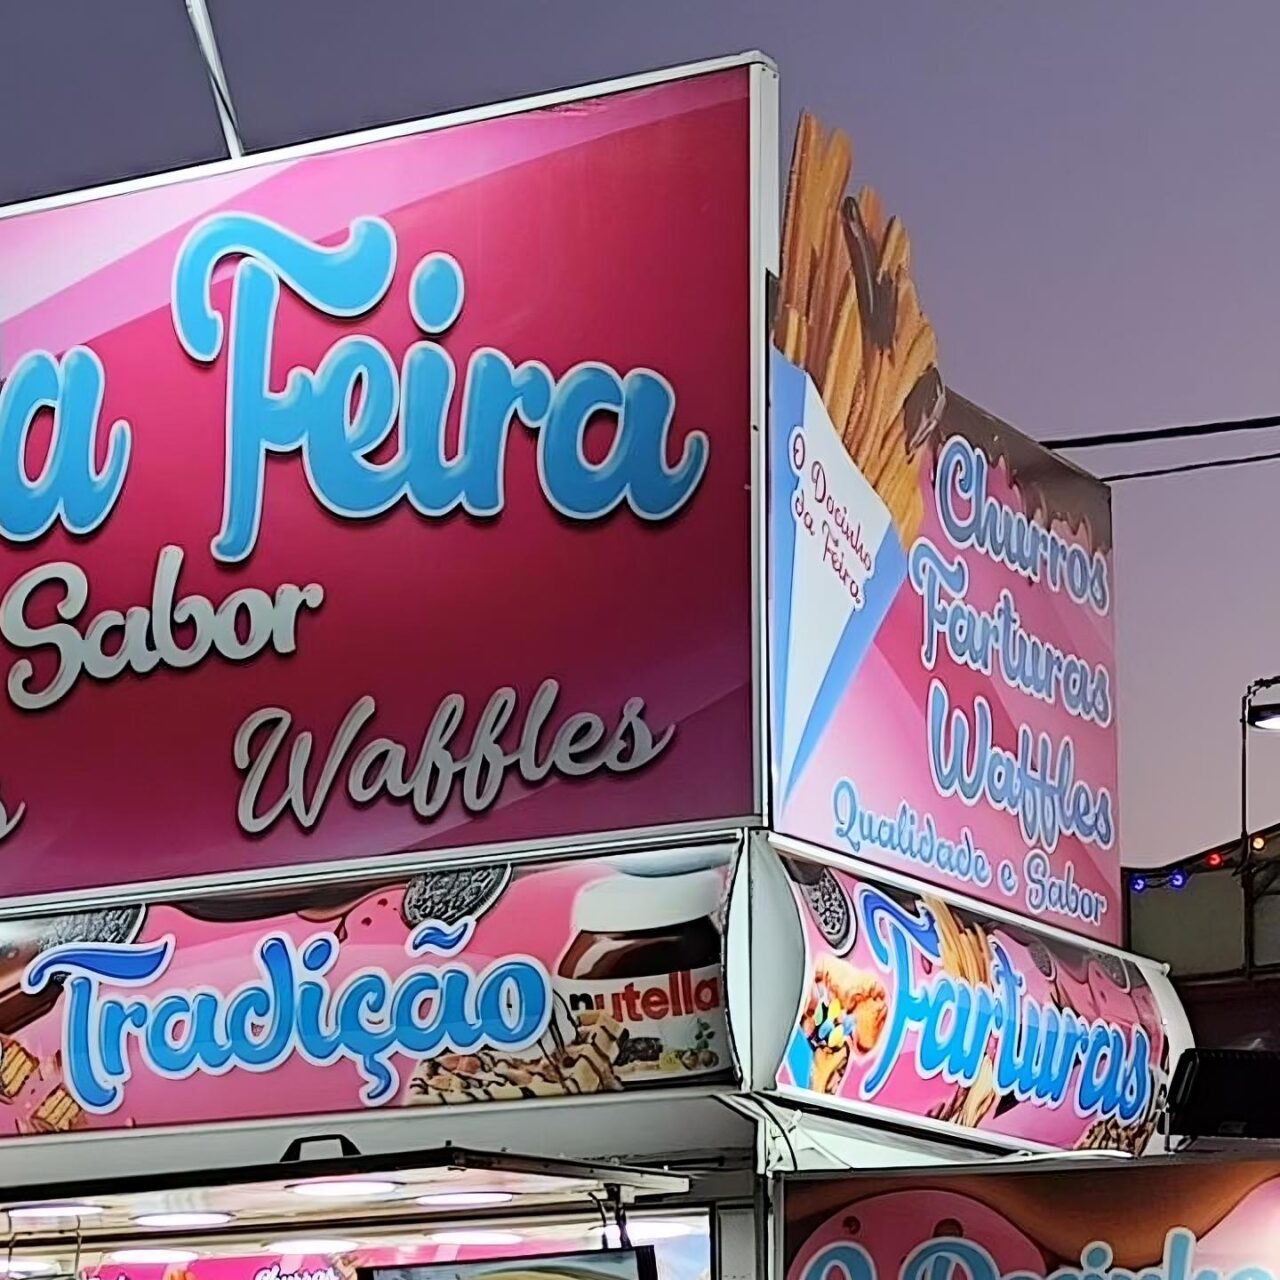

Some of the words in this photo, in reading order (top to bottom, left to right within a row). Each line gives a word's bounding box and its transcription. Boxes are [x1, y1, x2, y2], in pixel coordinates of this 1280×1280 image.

[171, 212, 709, 562] Feira
[793, 433, 805, 471] O
[811, 461, 871, 571] Docinho
[795, 488, 815, 536] da
[822, 520, 861, 604] Feira
[936, 433, 1110, 615] Churros
[0, 544, 323, 709] Sabor
[909, 536, 1112, 727] Farturas
[232, 677, 675, 834] Waffles
[926, 677, 1115, 852] Waffles
[832, 776, 992, 888] Qualidade
[998, 856, 1018, 896] e
[1023, 848, 1107, 925] Sabor
[22, 915, 554, 1116] Tradição
[570, 970, 720, 1023] nutella
[856, 880, 1152, 1121] Farturas
